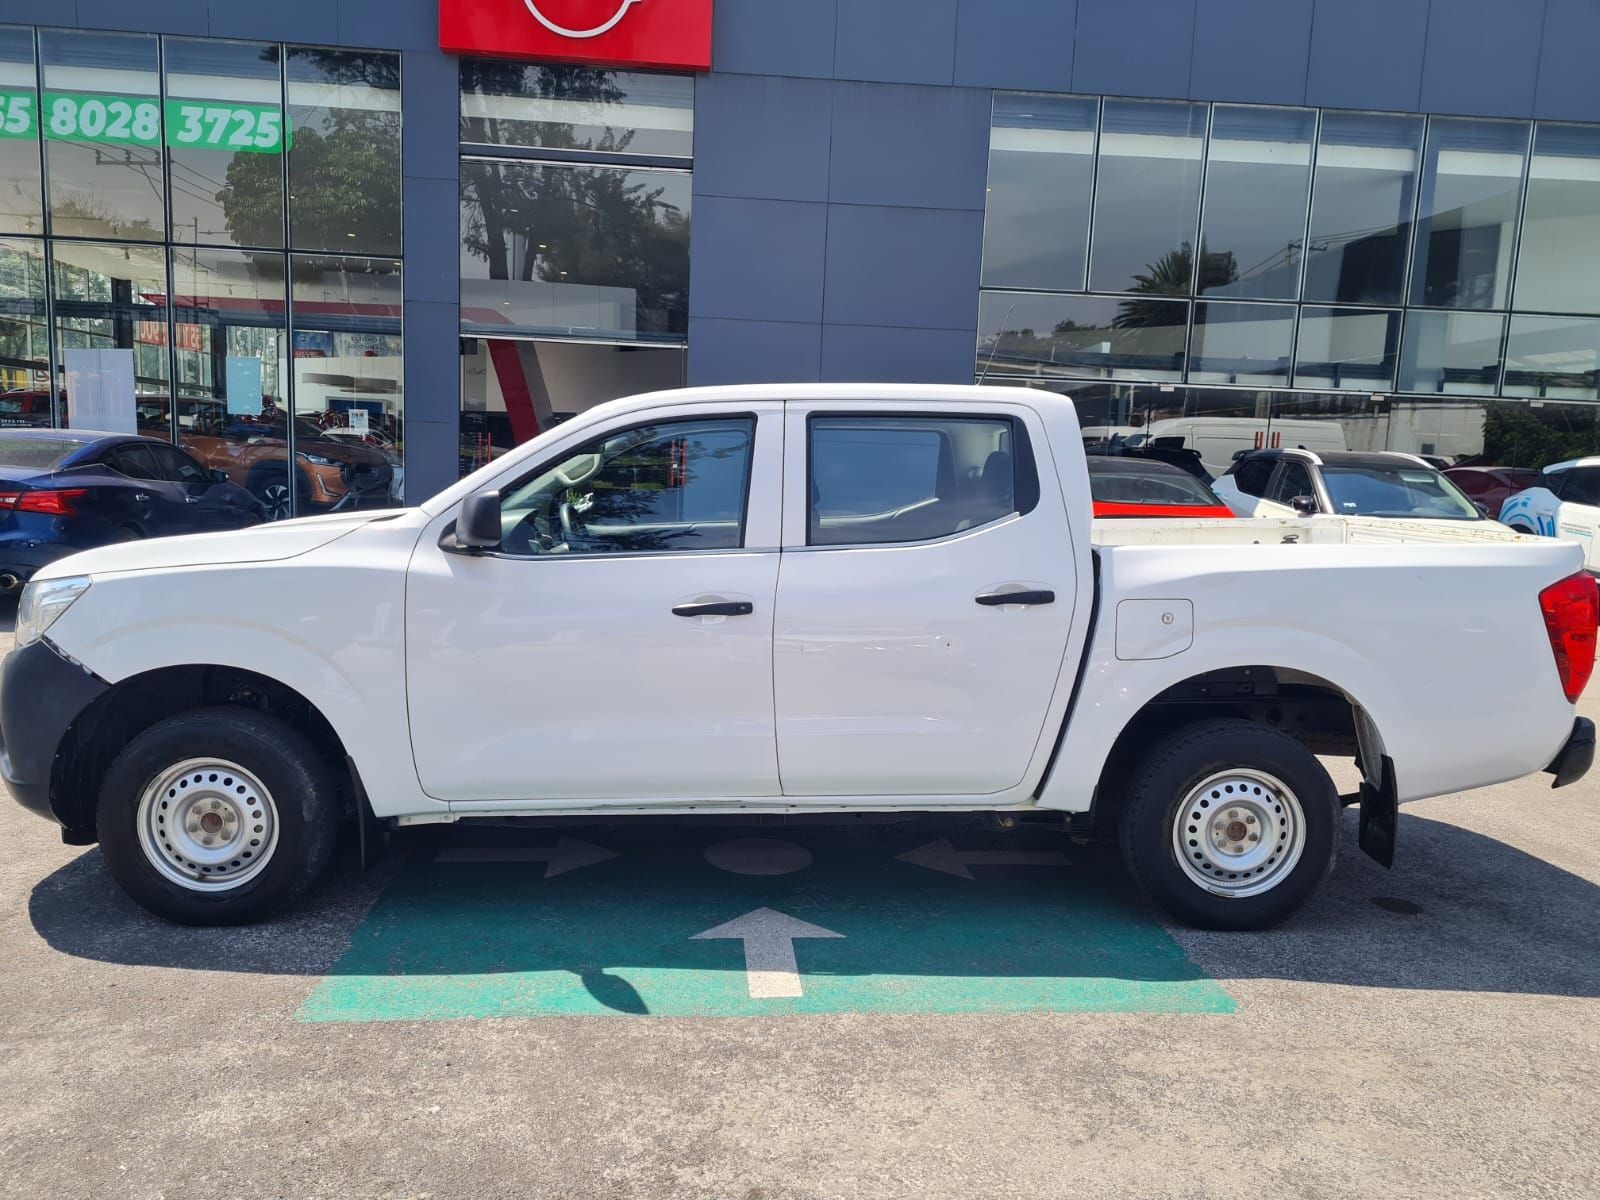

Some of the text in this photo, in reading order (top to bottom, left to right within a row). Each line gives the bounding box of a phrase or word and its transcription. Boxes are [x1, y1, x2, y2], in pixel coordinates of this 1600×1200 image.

[0, 96, 280, 148] 5 8028 3725
